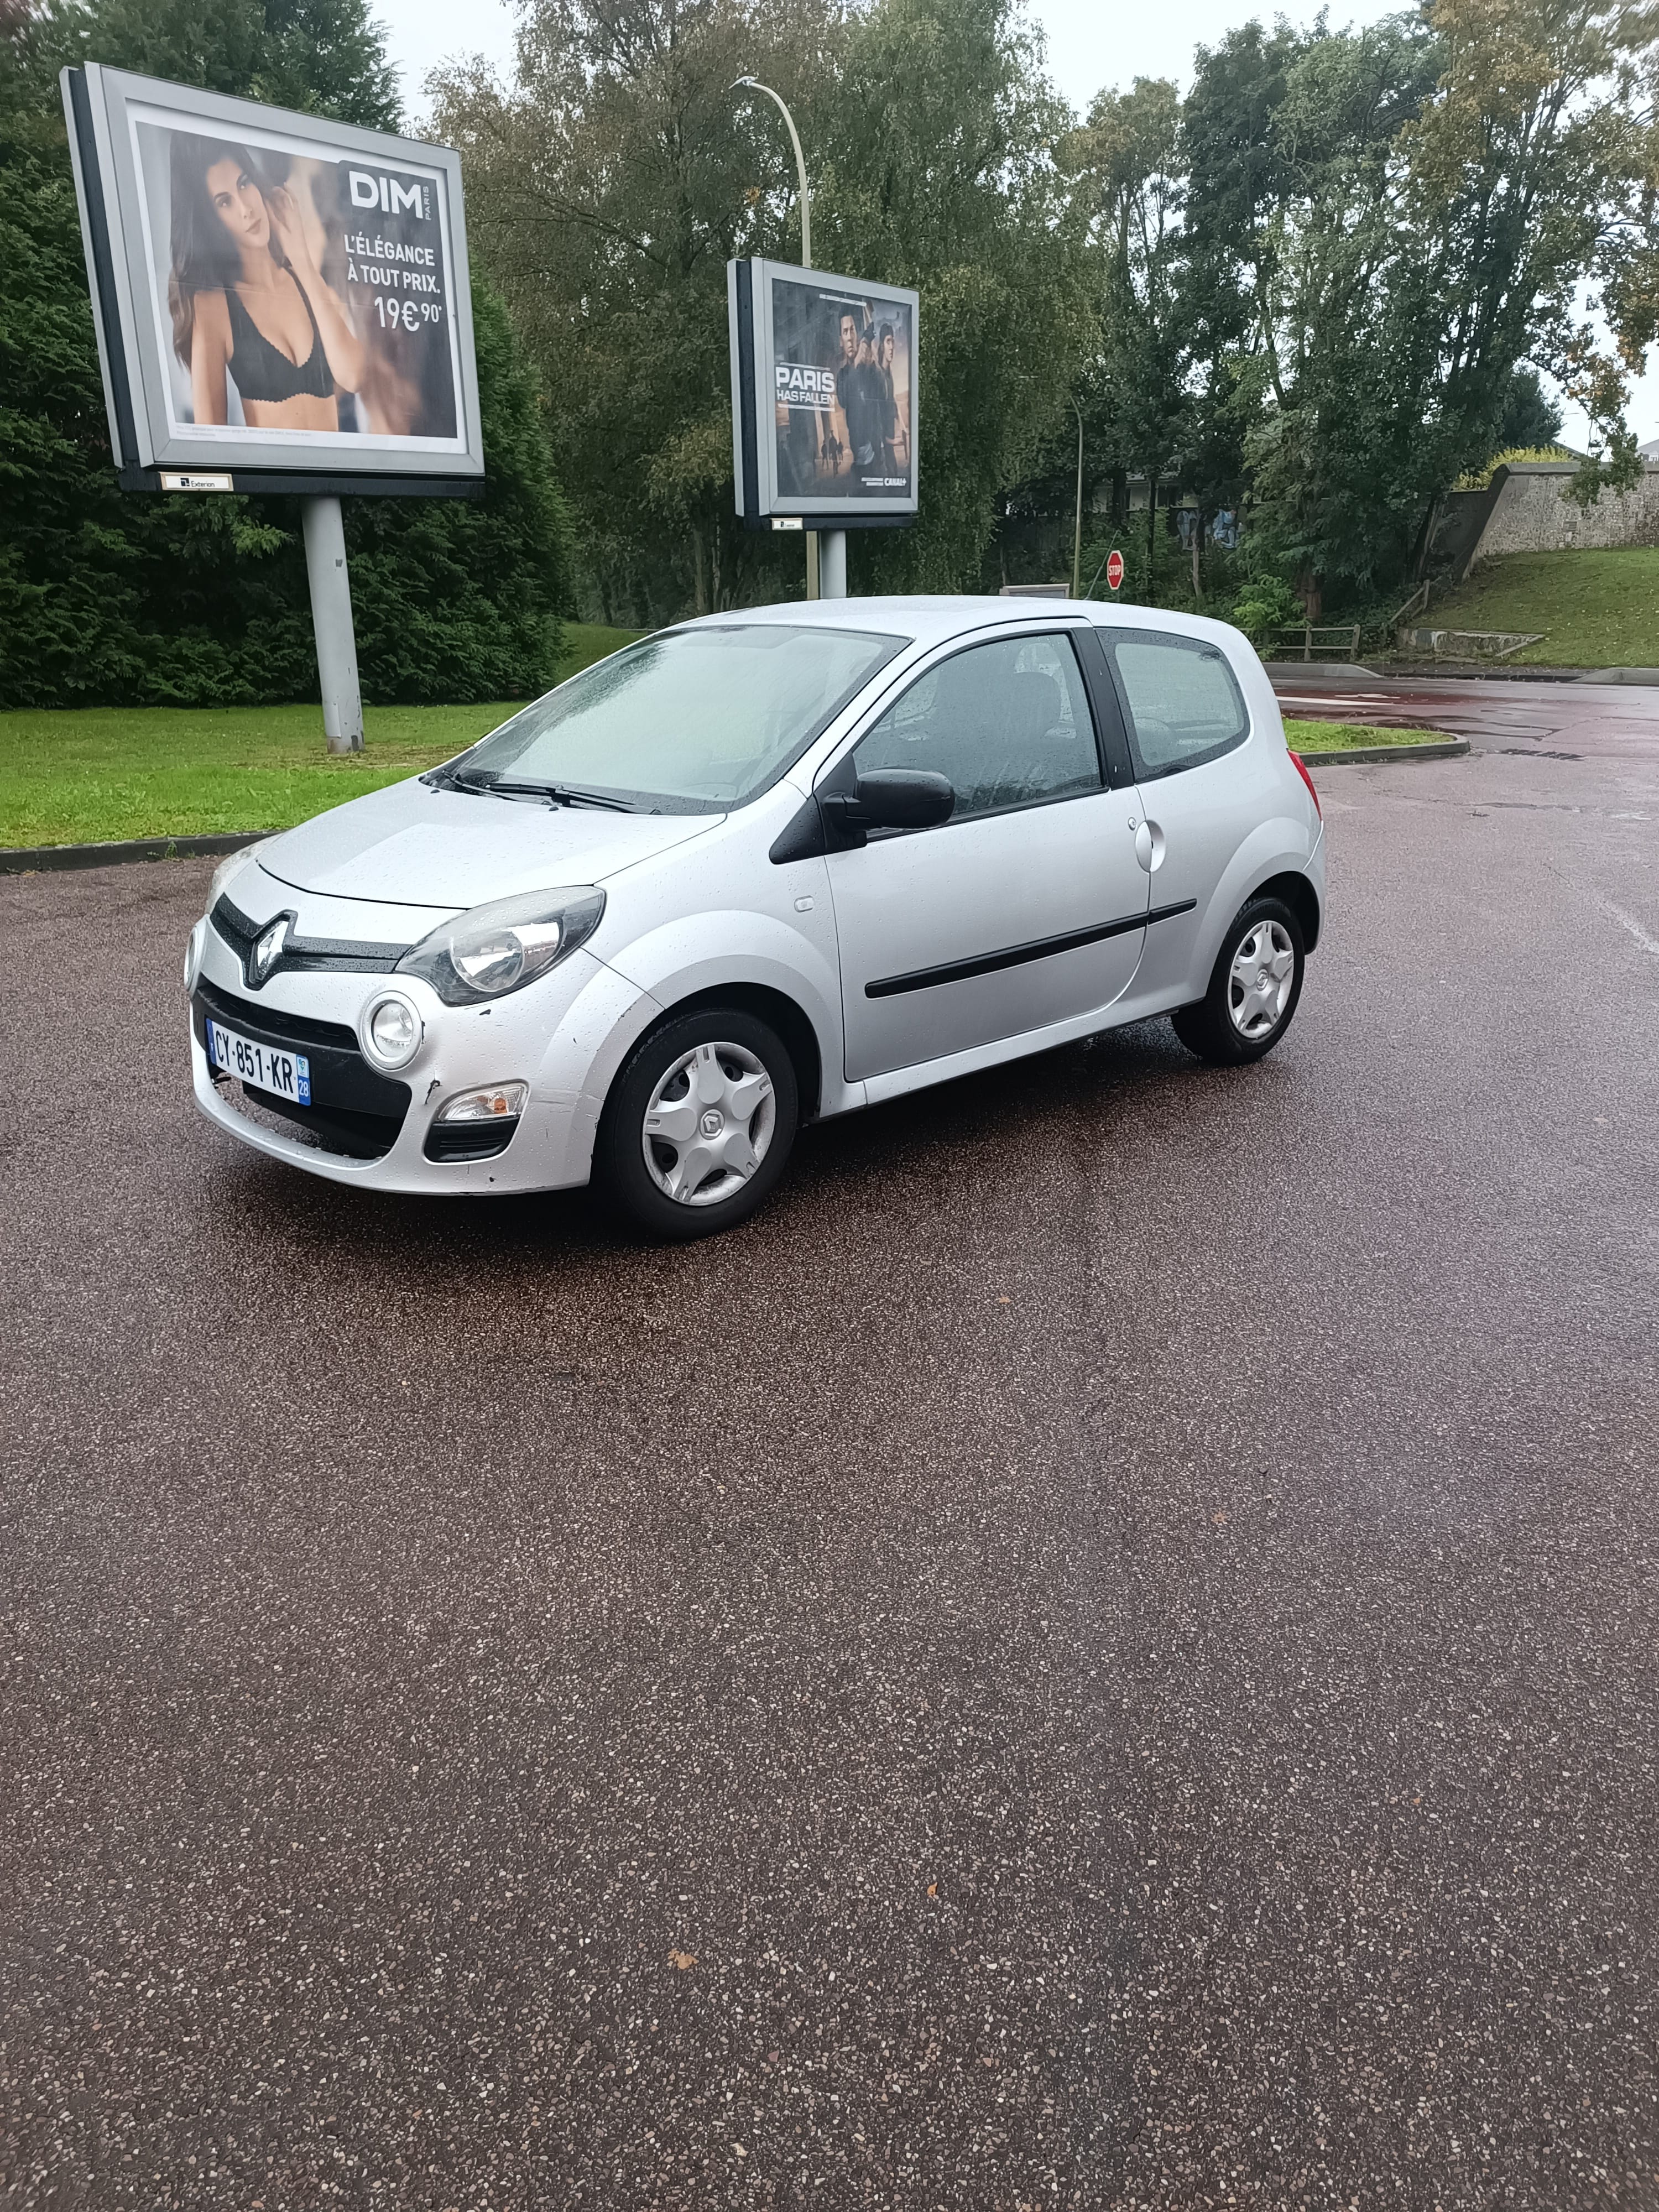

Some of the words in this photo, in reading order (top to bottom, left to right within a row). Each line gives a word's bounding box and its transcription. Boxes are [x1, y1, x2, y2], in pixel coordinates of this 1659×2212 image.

[349, 171, 423, 219] DIM
[422, 186, 431, 220] PARIS
[344, 231, 435, 267] L'ÉLÉGANCE
[347, 257, 358, 281] À
[360, 264, 400, 288] TOUT
[403, 271, 440, 294] PRIX.
[776, 367, 835, 393] PARIS
[776, 389, 799, 401] HAS
[799, 392, 836, 406] FALLEN
[1109, 565, 1121, 576] STOP
[299, 1079, 309, 1098] 28
